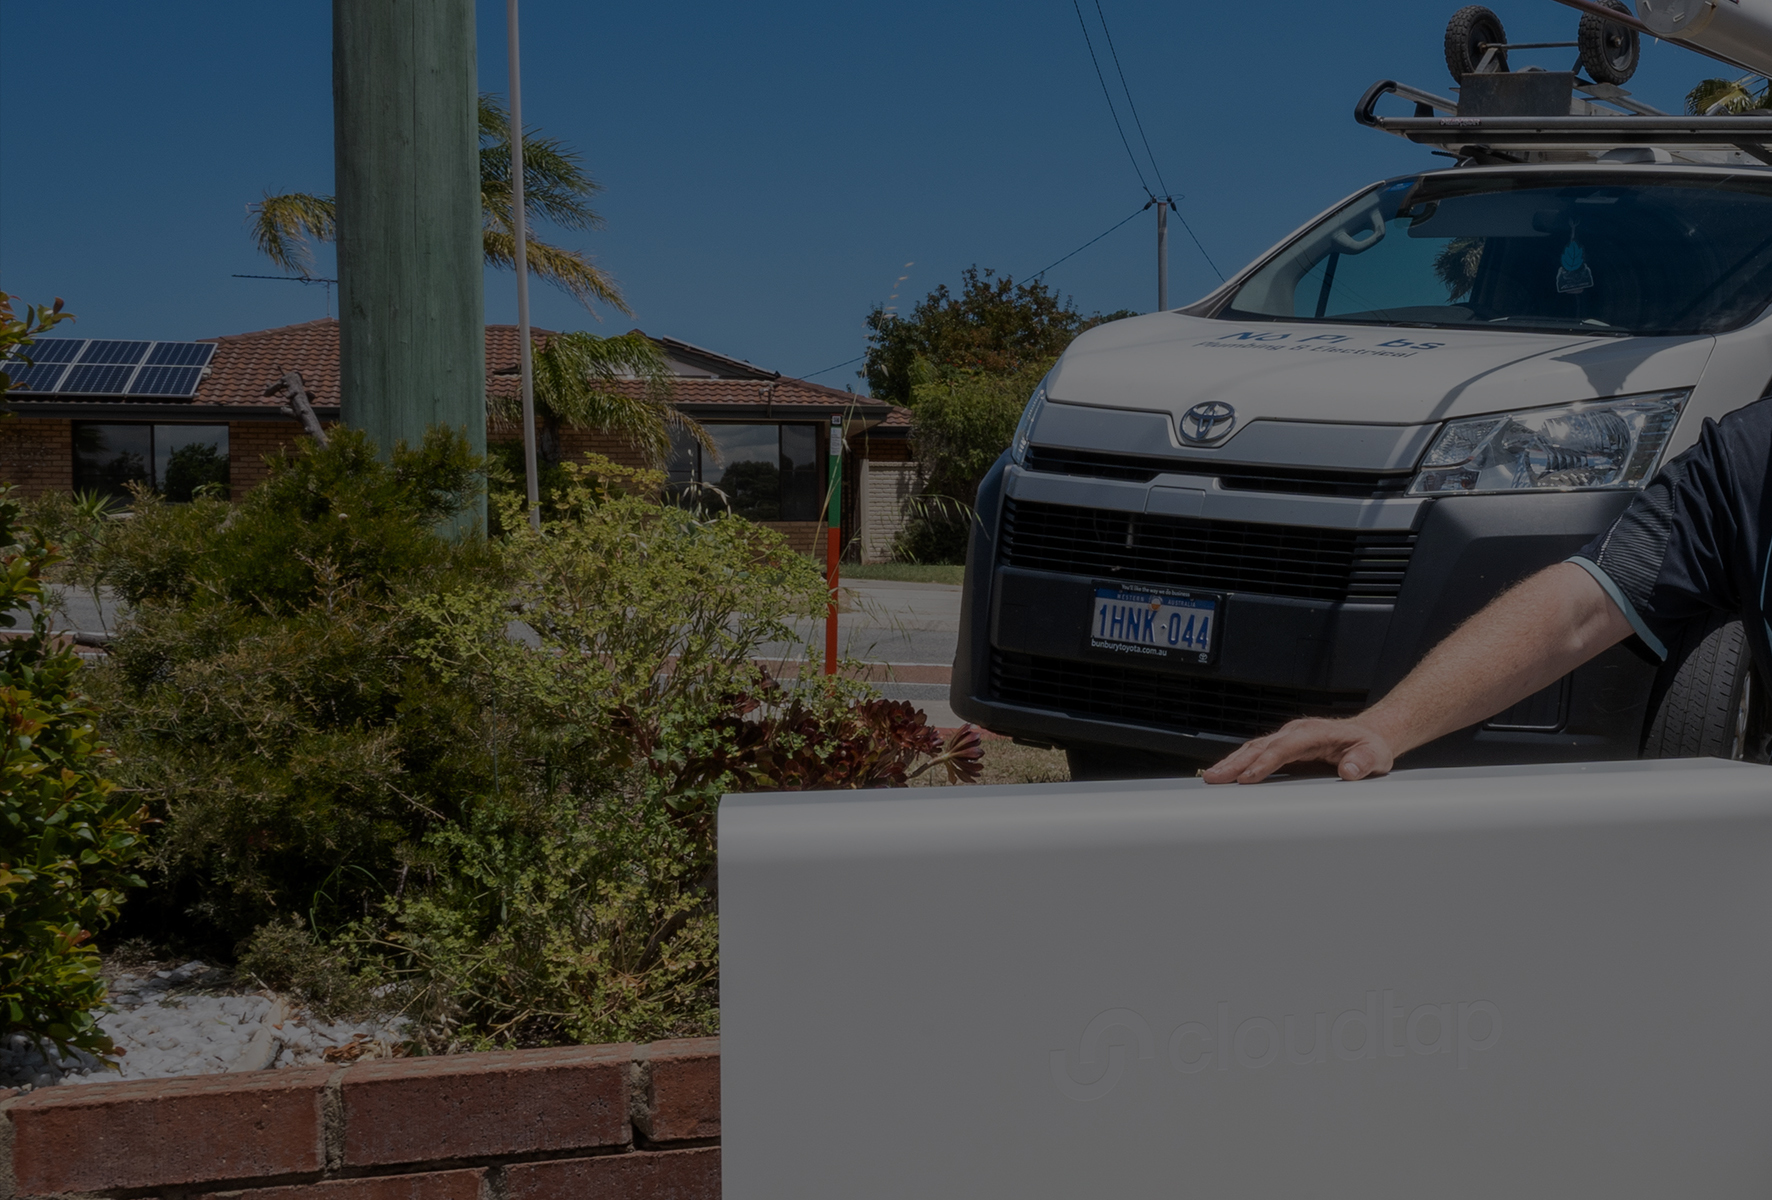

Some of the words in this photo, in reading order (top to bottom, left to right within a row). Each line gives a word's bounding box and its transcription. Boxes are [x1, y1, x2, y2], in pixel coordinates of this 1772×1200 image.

[1310, 345, 1418, 358] Electrical
[1117, 593, 1145, 602] WESTERN
[1167, 600, 1196, 608] AUSTRALIA
[1100, 604, 1157, 643] 1HNK
[1168, 612, 1209, 650] 044
[1091, 639, 1168, 657] bunburytoyota.com.au
[1167, 988, 1503, 1075] cloudtap
